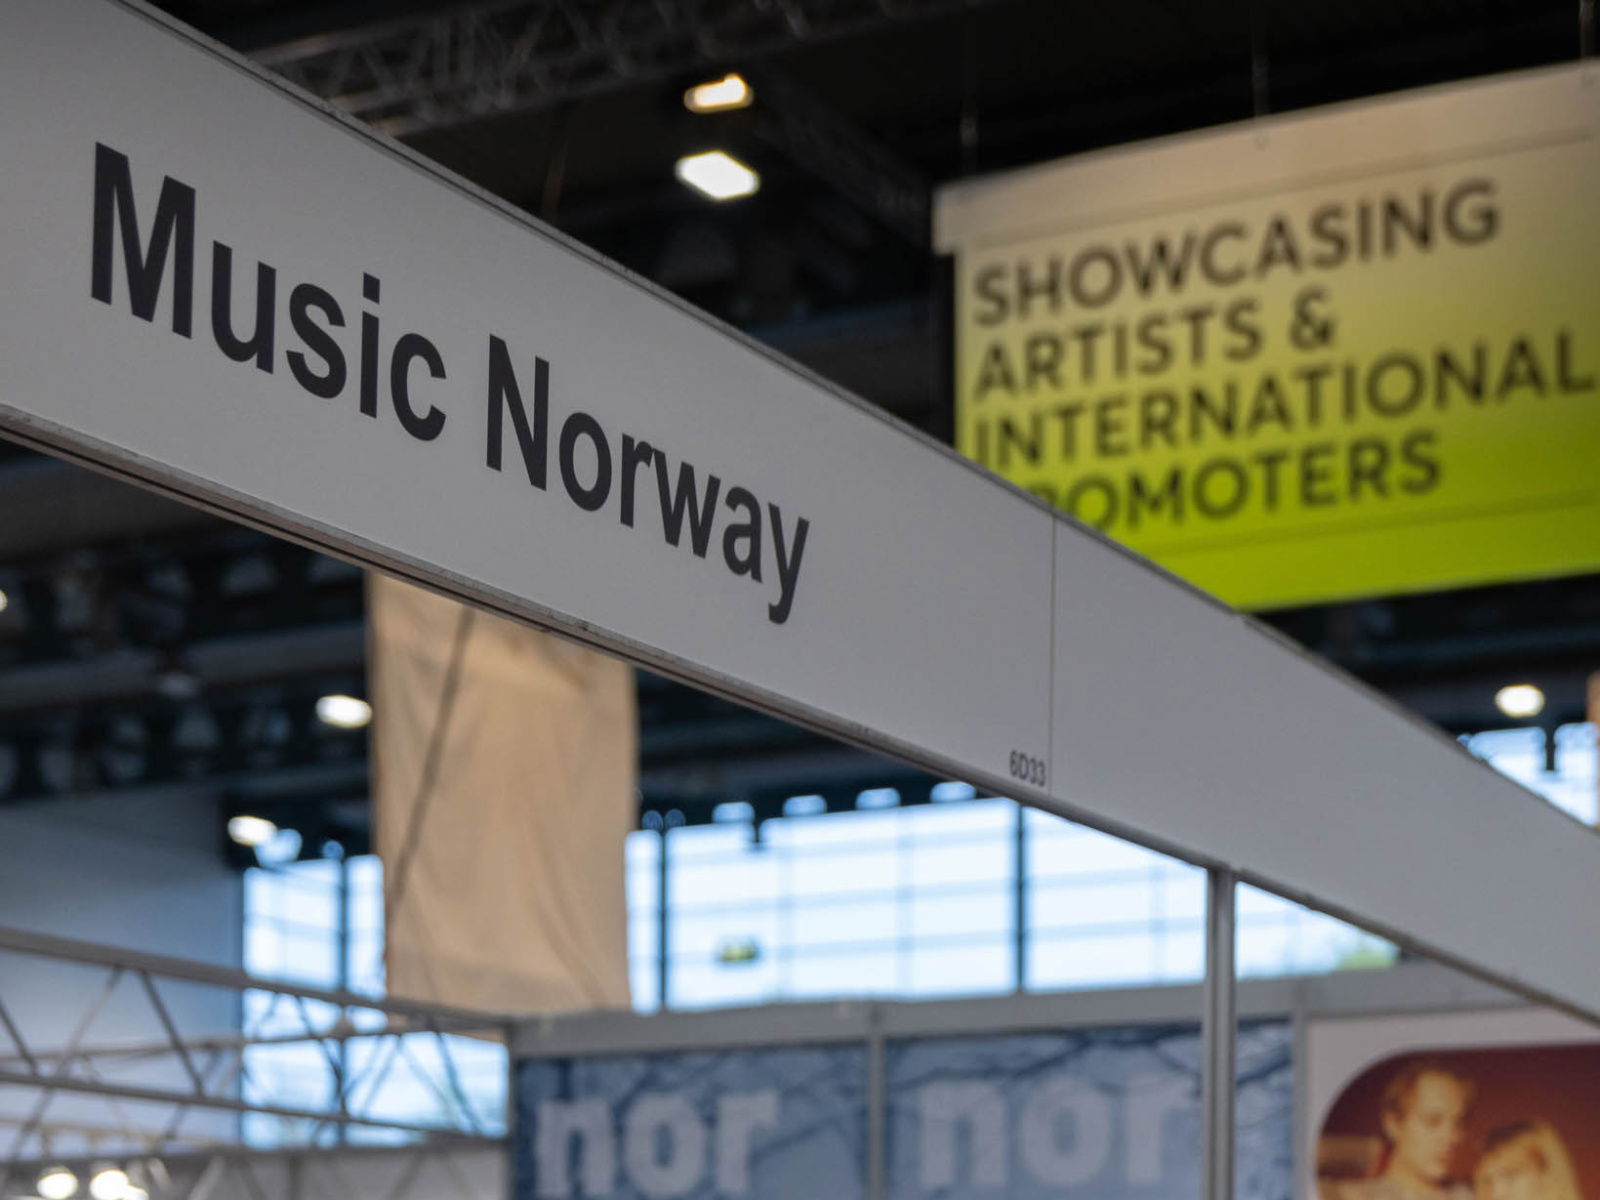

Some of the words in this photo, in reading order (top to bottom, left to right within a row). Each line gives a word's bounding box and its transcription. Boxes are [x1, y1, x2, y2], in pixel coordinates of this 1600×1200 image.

[972, 178, 1500, 327] SHOWCASING
[91, 141, 447, 442] Music
[486, 333, 810, 626] Norway
[972, 296, 1263, 399] ARTISTS
[1289, 286, 1335, 351] &
[975, 325, 1598, 470] INTERNATIONAL
[1009, 749, 1046, 788] 6D33
[534, 1090, 778, 1199] nor
[917, 1075, 1198, 1188] nor
